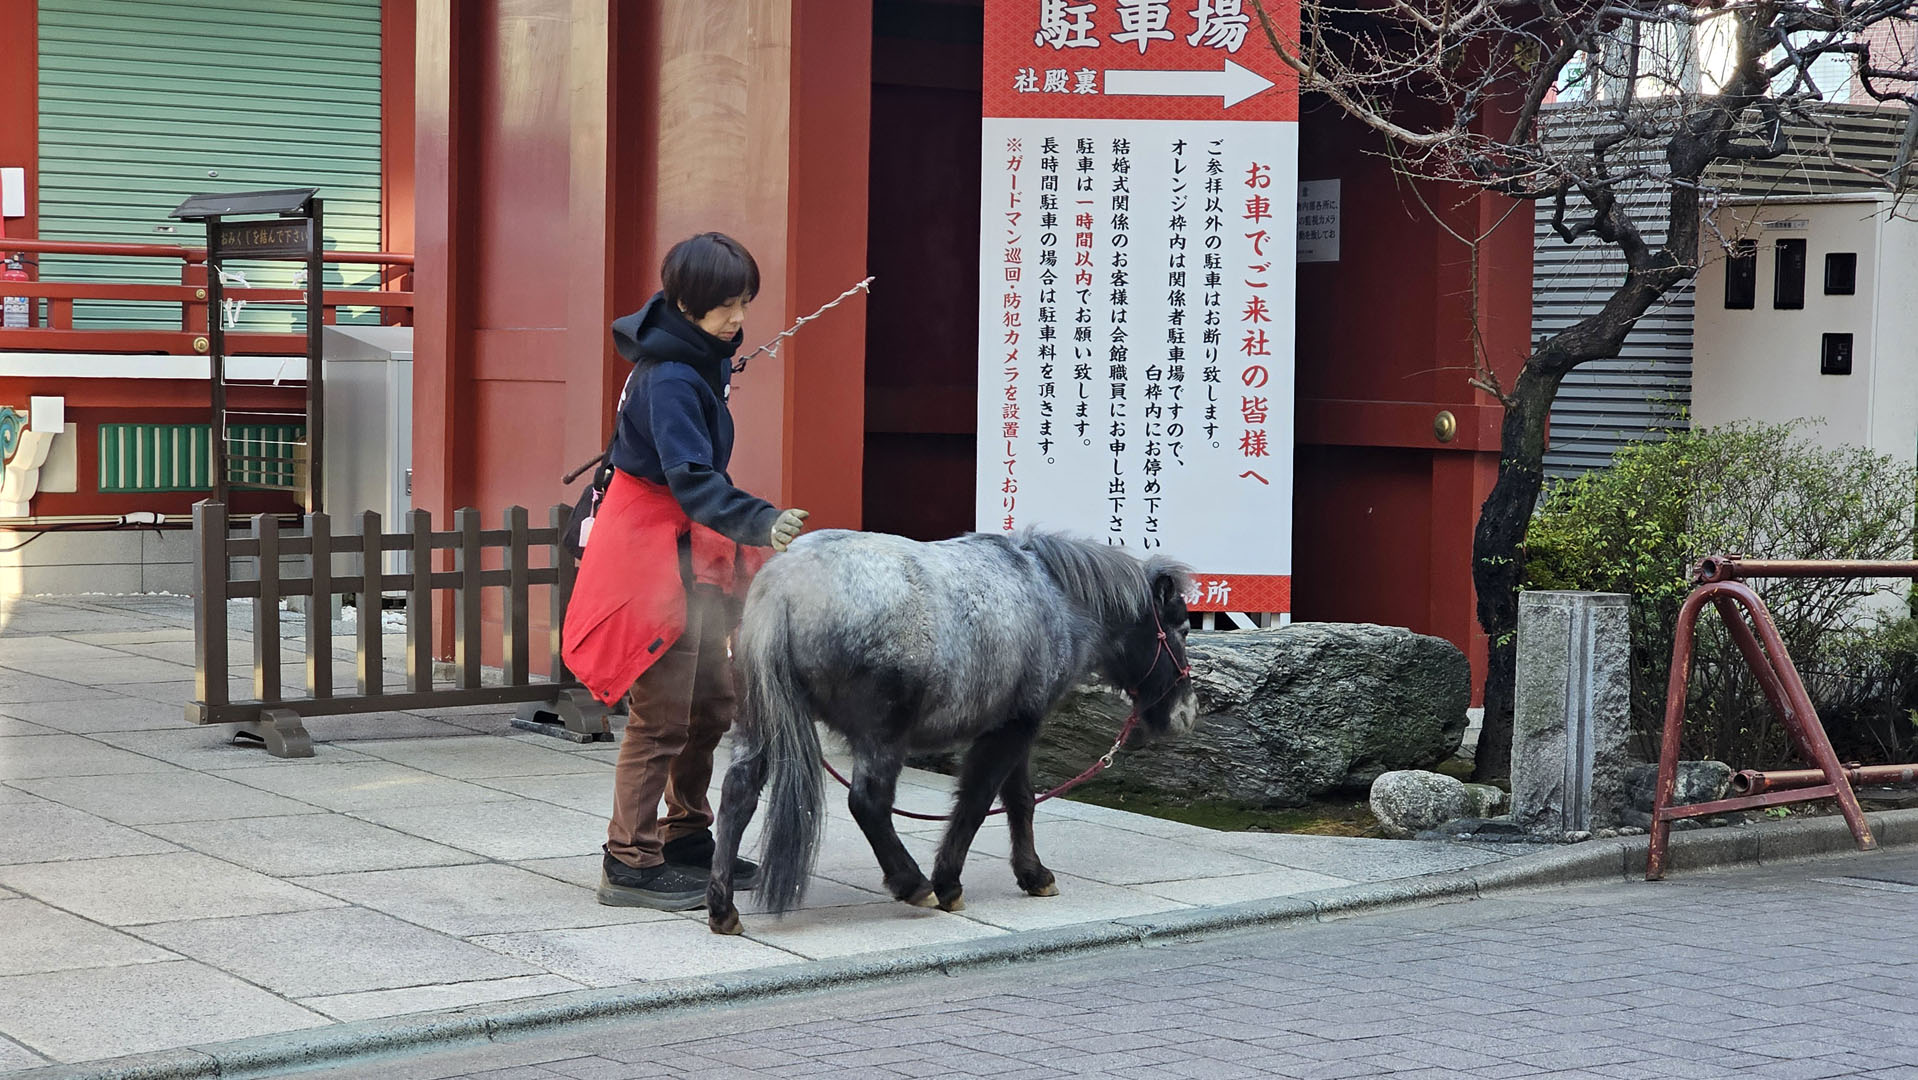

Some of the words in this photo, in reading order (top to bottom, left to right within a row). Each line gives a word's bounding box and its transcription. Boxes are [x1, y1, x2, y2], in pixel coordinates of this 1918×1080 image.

[1012, 67, 1099, 95] 社殿裏
[1034, 0, 1250, 54] 駐車場
[1001, 137, 1023, 534] ※ガードマン巡回・防犯カメラを設置しておりま
[1037, 136, 1060, 465] 長時間駐車の場合は駐車料を頂きます。
[1073, 137, 1096, 447] 駐車は一時間以内でお願い致します。
[1166, 138, 1188, 466] オレンジ枠内は関係者駐車場ですので、
[1202, 138, 1224, 449] ご参拝以外の駐車はお断り致します。
[1238, 161, 1273, 486] お車でご来社の皆様へ
[1143, 364, 1163, 550] 白枠内にお停め下さい
